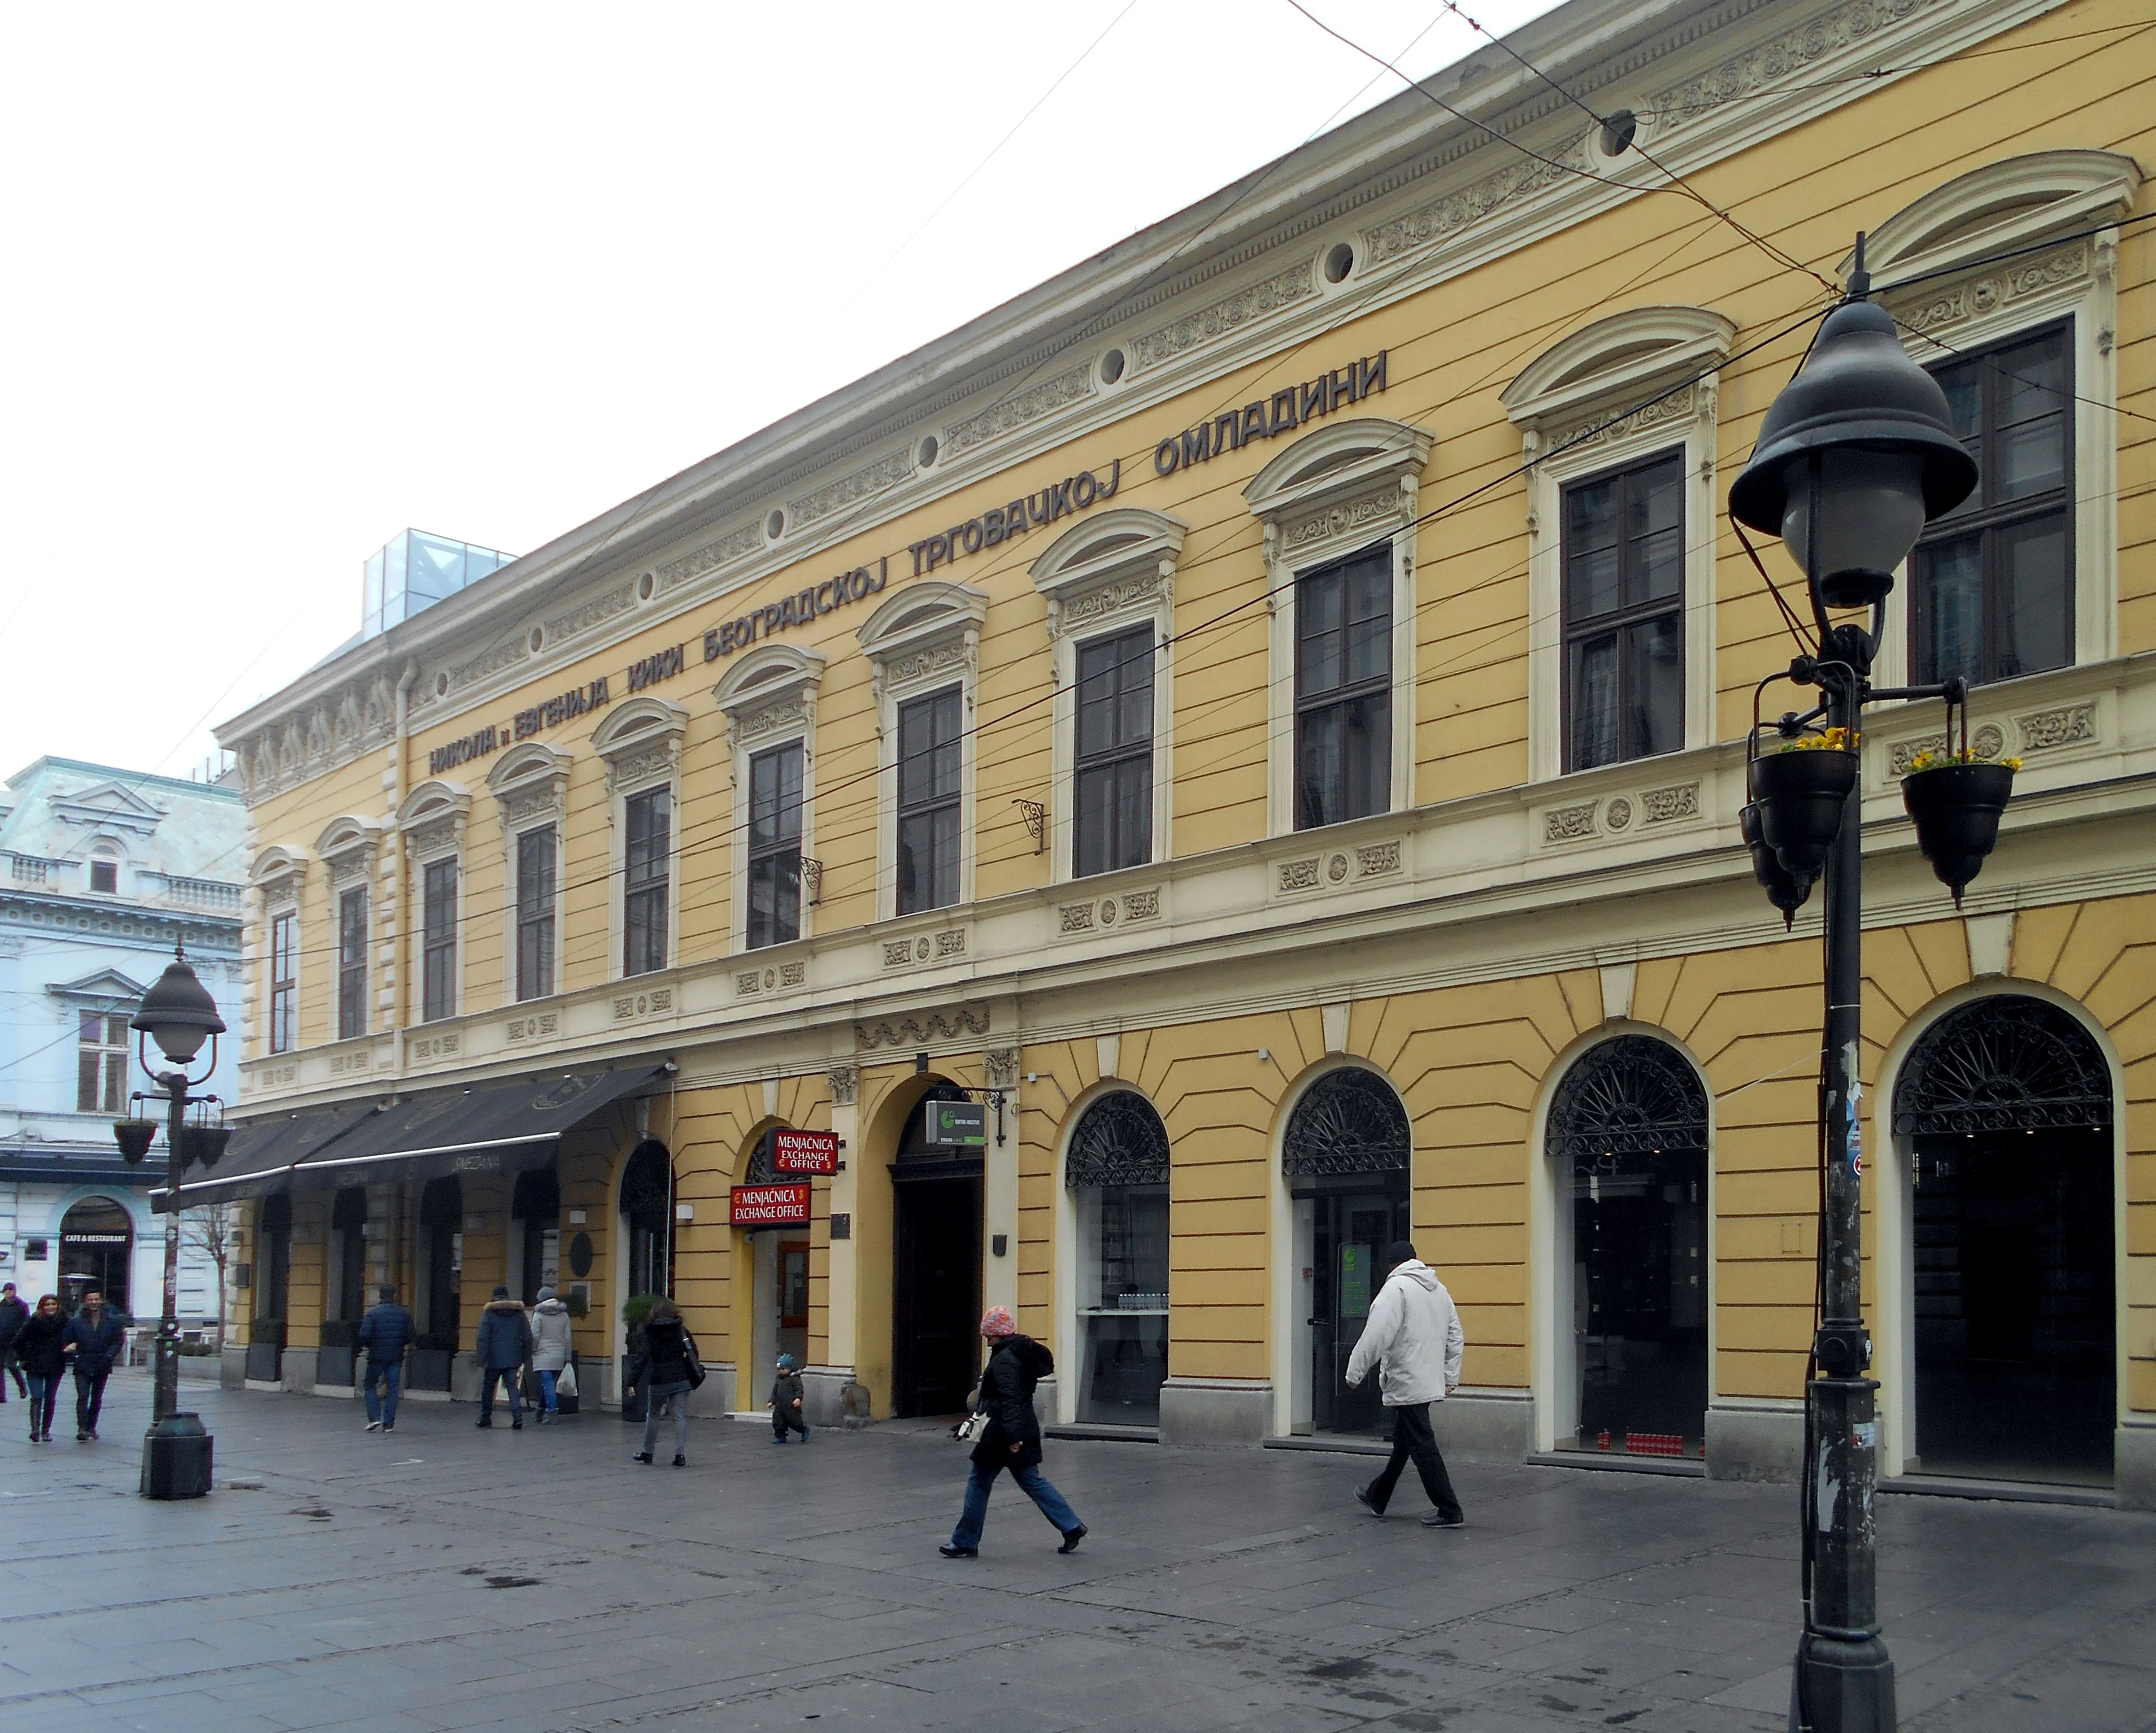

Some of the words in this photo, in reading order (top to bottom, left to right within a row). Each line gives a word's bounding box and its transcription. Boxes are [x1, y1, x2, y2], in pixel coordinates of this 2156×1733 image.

[430, 724, 497, 775] НИКОЛА
[514, 676, 609, 740] ЕВГЕНИЈА
[628, 643, 684, 693] КИКИ
[704, 556, 888, 662] БЕОГРАДСКОЈ
[908, 458, 1120, 577] ТРГОВАЧКОЈ
[1154, 349, 1387, 476] ОМЛАДИНИ
[778, 1136, 834, 1151] MENJAČNICA
[782, 1150, 829, 1161] EXCHANGE
[790, 1159, 820, 1169] OFFICE
[742, 1188, 795, 1206] MENJAČNICA
[735, 1206, 775, 1219] EXCHANGE
[777, 1205, 804, 1217] OFFICE
